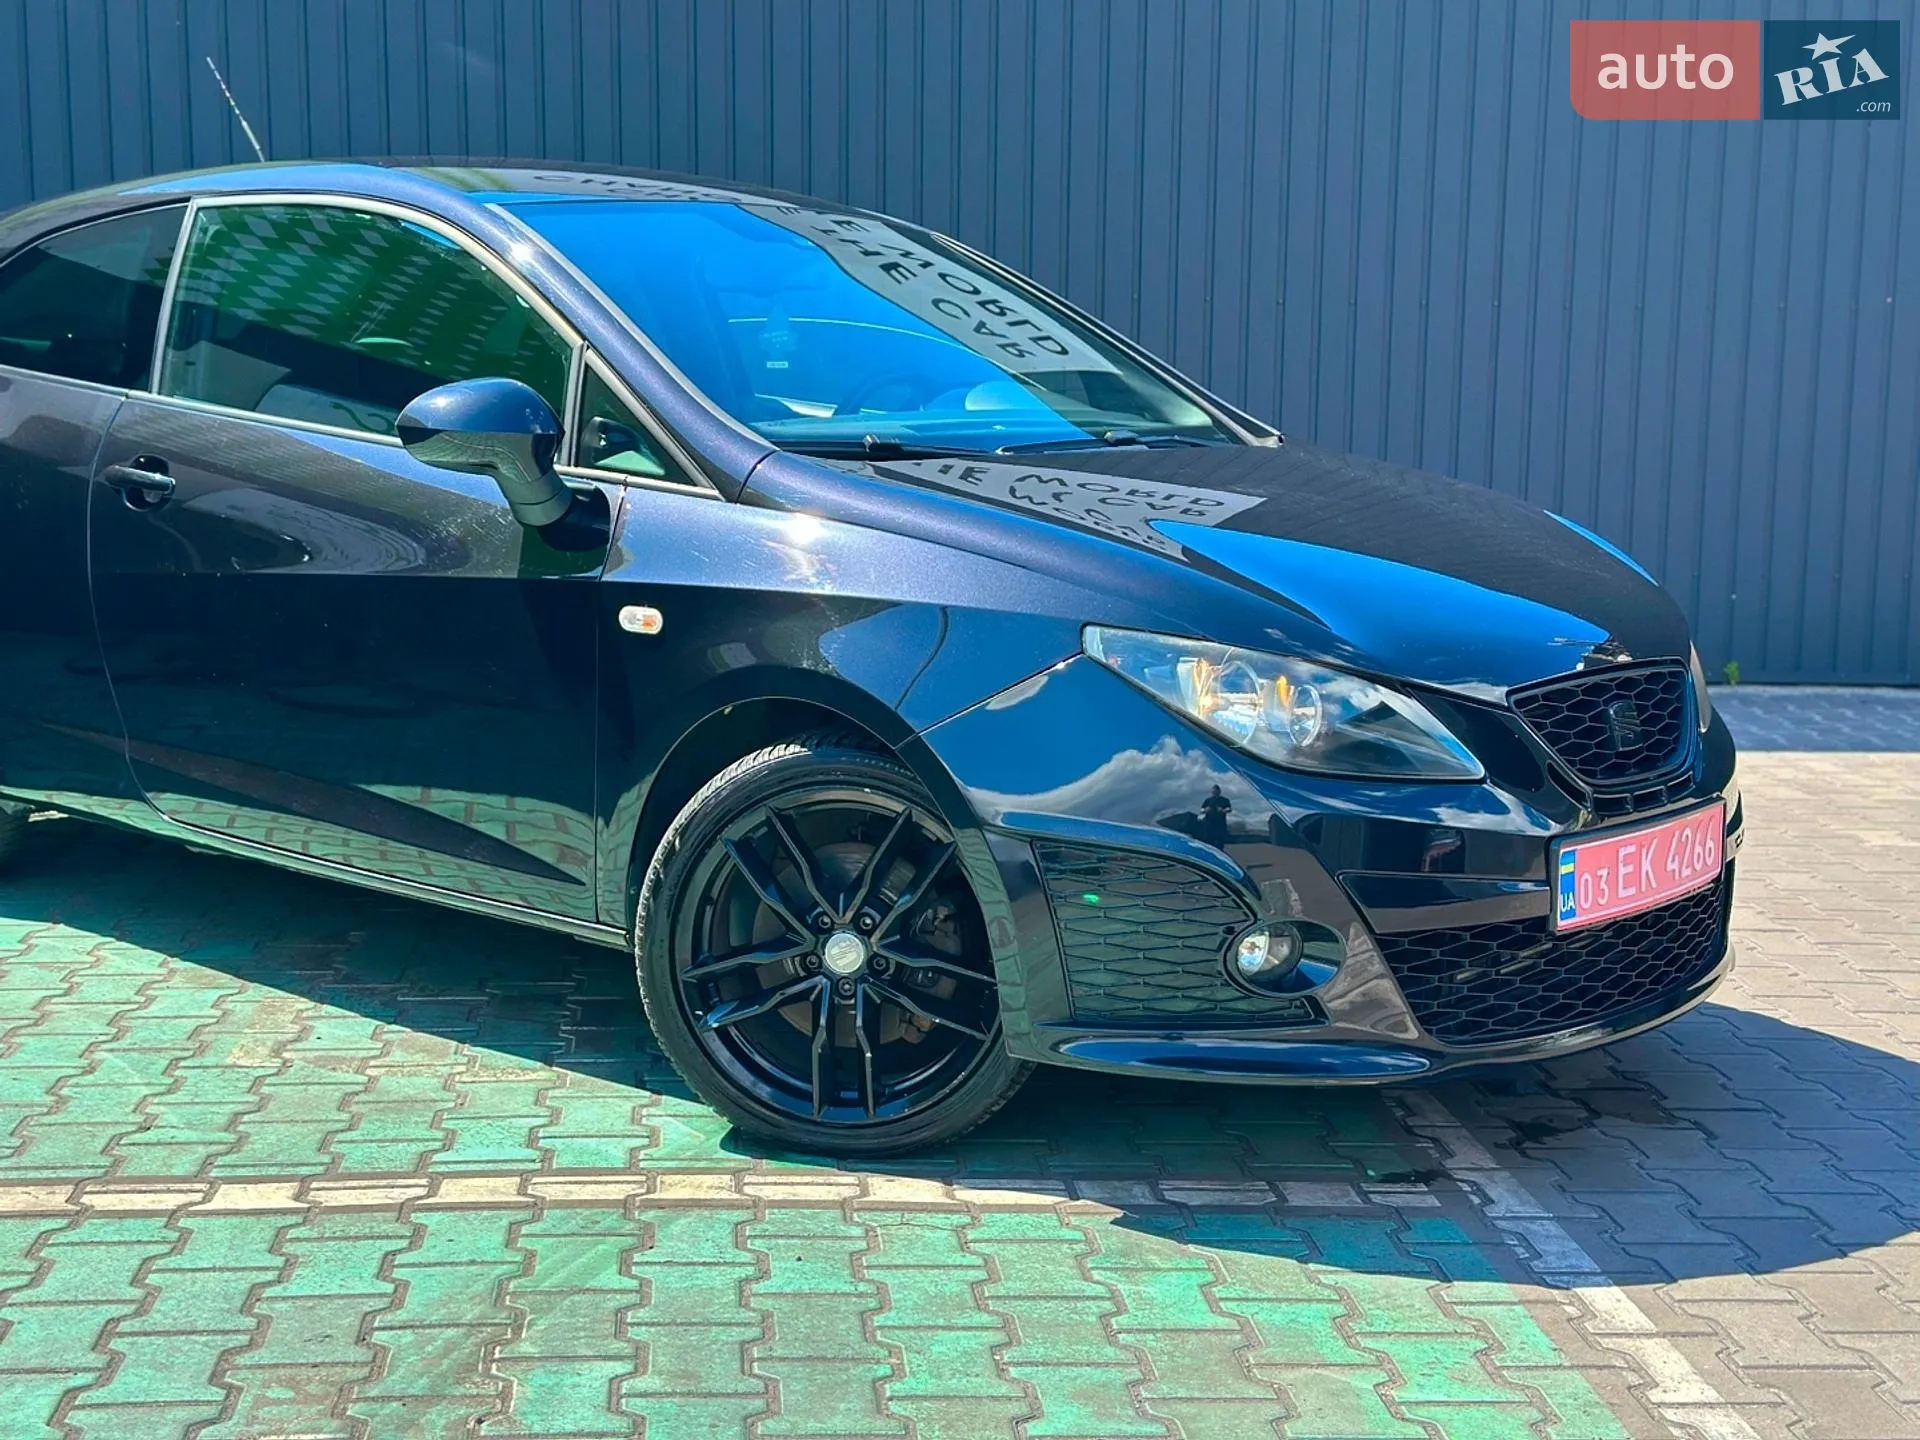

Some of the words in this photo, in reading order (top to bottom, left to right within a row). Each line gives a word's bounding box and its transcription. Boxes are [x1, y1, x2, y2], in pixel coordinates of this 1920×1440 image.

[1580, 867, 1609, 909] 03
[1618, 838, 1659, 899] EK
[1666, 815, 1715, 881] 4266
[1560, 891, 1575, 912] UA
